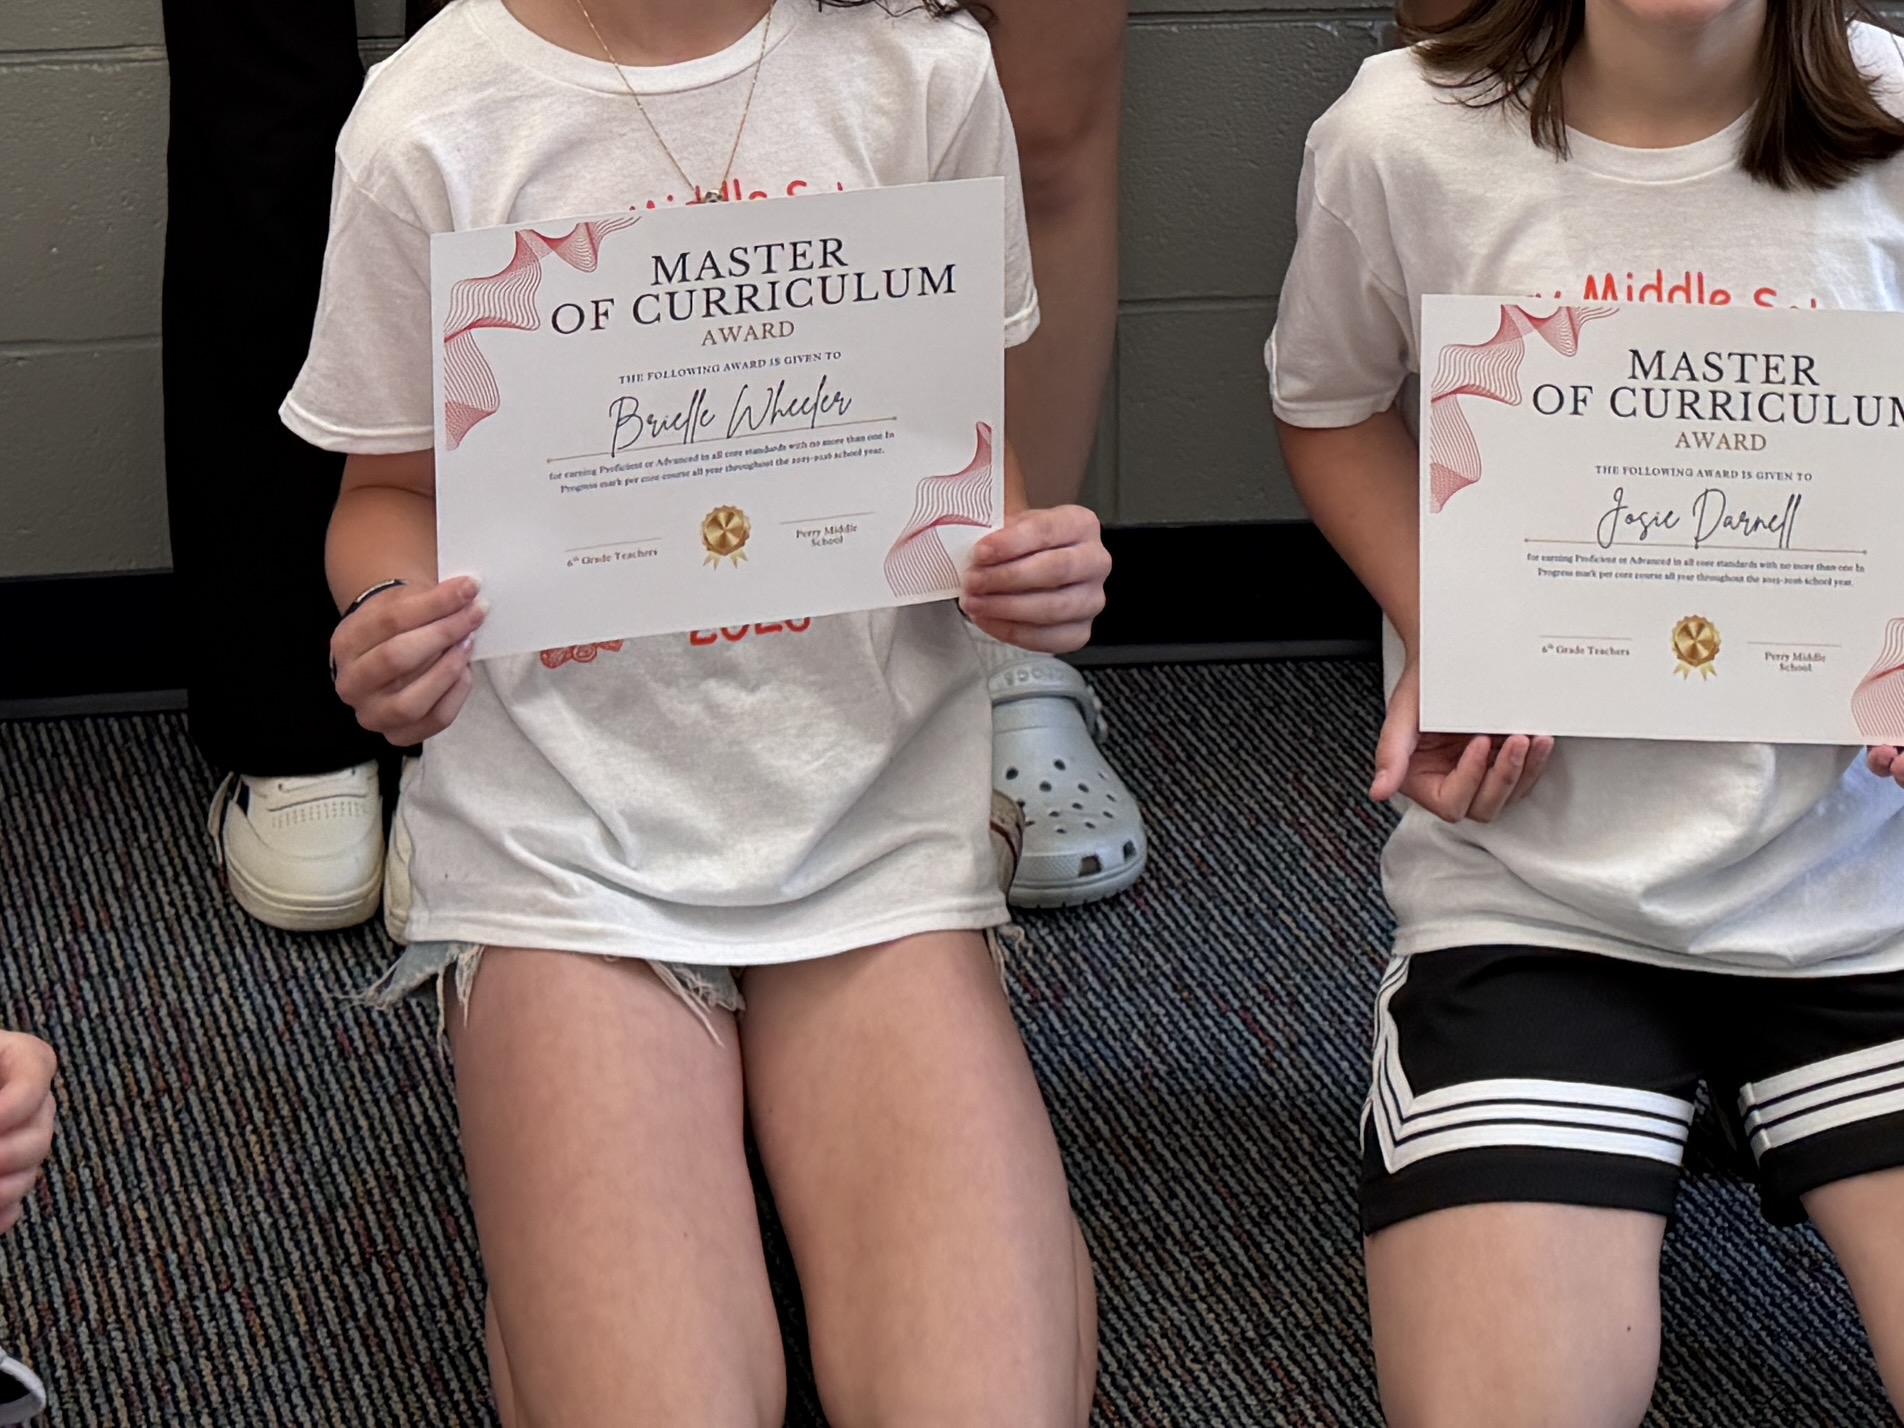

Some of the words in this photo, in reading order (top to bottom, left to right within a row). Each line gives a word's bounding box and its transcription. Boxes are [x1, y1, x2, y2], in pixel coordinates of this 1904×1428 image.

[651, 238, 848, 285] MASTER
[551, 298, 614, 334] OF
[633, 264, 955, 324] CURRICULUM
[702, 321, 794, 346] AWARD
[618, 373, 644, 385] THE
[646, 363, 720, 381] FOLLOWING
[722, 358, 767, 372] AWARD
[769, 356, 781, 366] IS
[783, 352, 822, 365] GIVEN
[824, 350, 842, 360] TO
[1628, 349, 1819, 385] MASTER
[608, 387, 716, 458] Brielle
[725, 374, 852, 439] Wheeler
[1533, 384, 1592, 415] OF
[1675, 431, 1766, 450] AWARD
[1594, 464, 1619, 475] THE
[1622, 465, 1693, 477] FOLLOWING
[1696, 468, 1739, 479] AWARD
[1740, 469, 1753, 479] IS
[1755, 470, 1793, 481] GIVEN
[1796, 471, 1813, 482] TO
[1596, 486, 1680, 549] Josie
[1692, 487, 1802, 550] Darnell
